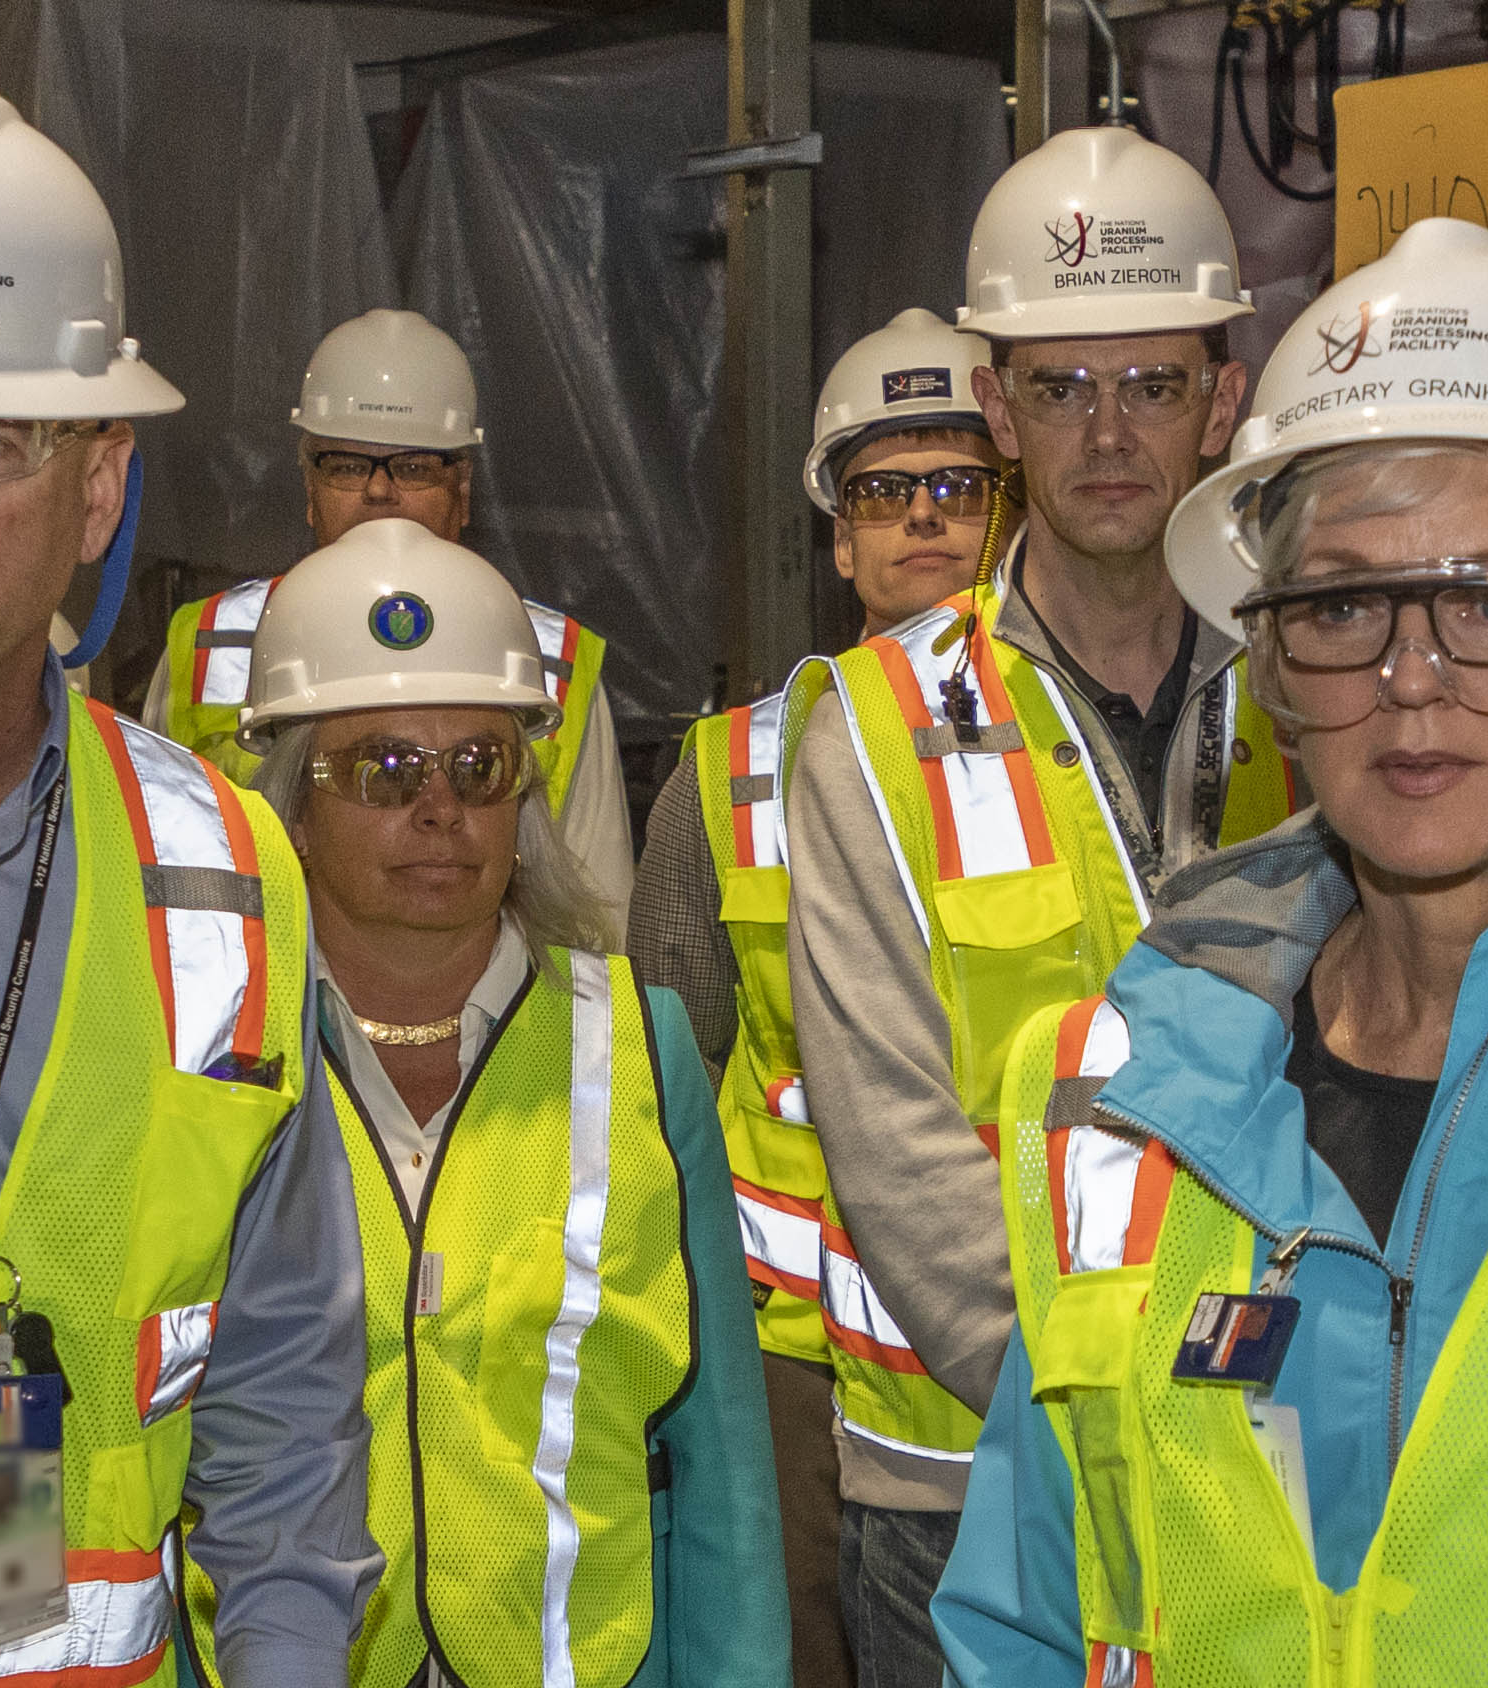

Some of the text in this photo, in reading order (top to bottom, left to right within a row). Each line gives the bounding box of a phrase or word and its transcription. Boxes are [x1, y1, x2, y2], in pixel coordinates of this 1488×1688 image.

[1100, 227, 1147, 235] URANIUM
[1101, 236, 1164, 245] PROCESSING
[1101, 246, 1144, 254] FACILITY
[1055, 268, 1181, 288] BRIAN ZIEROTH
[1392, 316, 1468, 327] URANIUM
[1388, 339, 1459, 351] FACILITY
[1274, 380, 1394, 432] SECRETARY
[39, 823, 56, 865] National
[33, 866, 48, 888] Y-12
[0, 987, 23, 1032] Security
[13, 938, 32, 986] Complex
